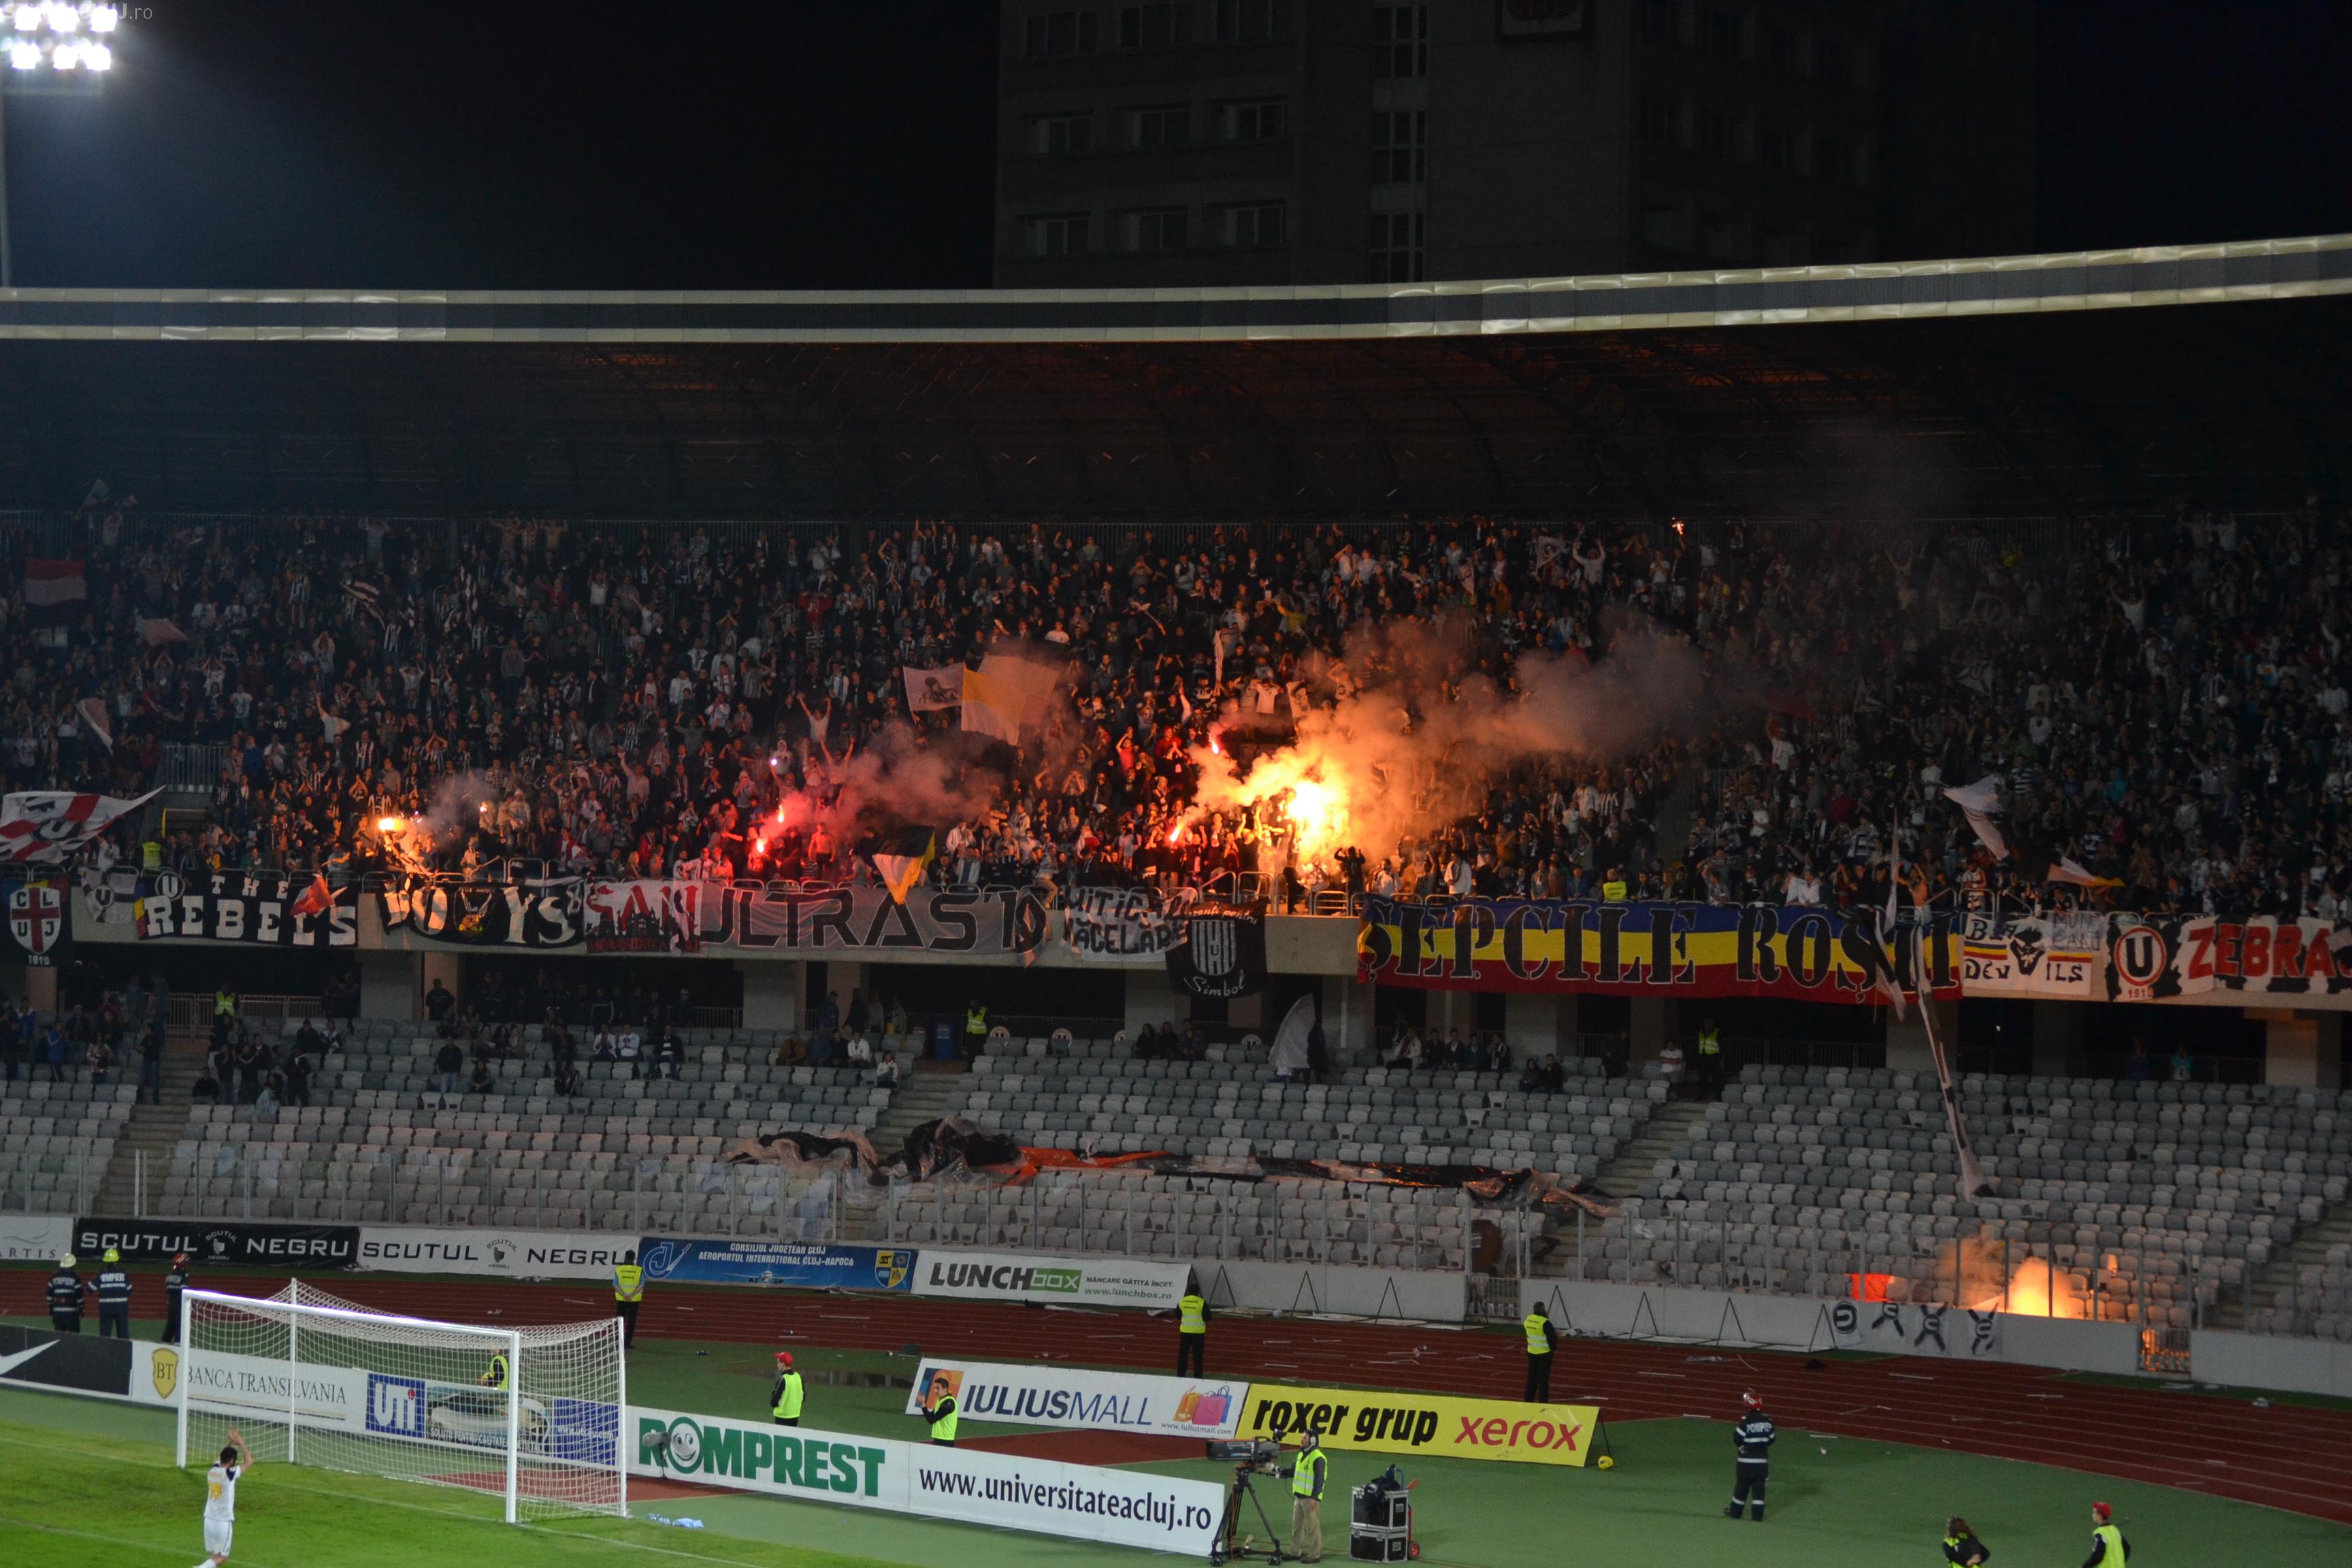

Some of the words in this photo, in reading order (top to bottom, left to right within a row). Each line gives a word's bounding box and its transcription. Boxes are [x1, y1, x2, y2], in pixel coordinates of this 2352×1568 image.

[161, 875, 178, 897] U
[212, 875, 289, 899] THE
[95, 887, 111, 906] U
[144, 896, 355, 946] REBELS
[2125, 936, 2153, 978] U
[1184, 969, 1244, 997] Simbol
[80, 1232, 198, 1252] SCUTUL
[206, 1230, 237, 1243] SCUTUL
[486, 1238, 519, 1252] SCUTUL
[0, 1246, 56, 1258] RTIS
[246, 1238, 349, 1256] NEGRU
[363, 1235, 479, 1260] SCUTUL
[527, 1247, 627, 1266] NEGRU
[730, 1242, 767, 1253] CONSILIUL
[808, 1246, 826, 1256] CLUJ
[698, 1252, 744, 1263] AEROPORTUL
[803, 1256, 854, 1267] CLUJ-NAPOCA
[1084, 1288, 1173, 1300] www.lunchbox.ro
[157, 1362, 174, 1380] BT
[238, 1371, 347, 1405] TRANSILVANIA
[1161, 1422, 1232, 1435] www.iuliusmall.com
[1252, 1399, 1350, 1435] roxer
[1353, 1405, 1439, 1446] grup
[1454, 1416, 1583, 1452] xerox
[919, 1468, 1212, 1532] www.universitateacluj.ro
